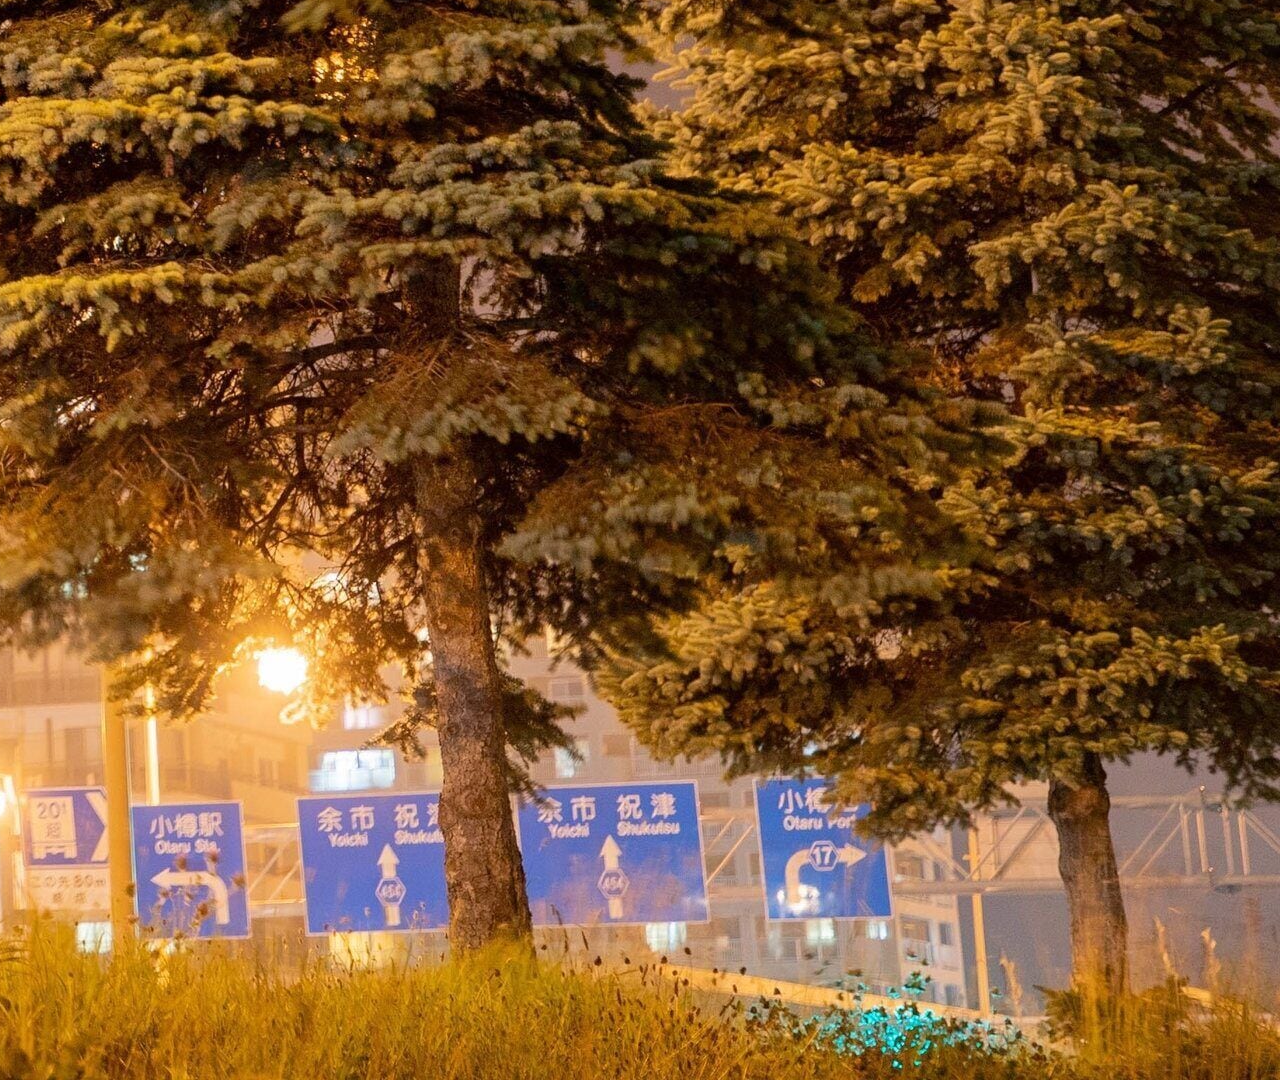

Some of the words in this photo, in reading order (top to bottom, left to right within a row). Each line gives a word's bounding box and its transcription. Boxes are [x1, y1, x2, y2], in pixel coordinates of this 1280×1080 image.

[537, 796, 596, 823] 余市
[616, 792, 677, 819] 祝津
[778, 787, 858, 814] 小樽
[149, 811, 224, 839] 小樽駅
[317, 805, 375, 832] 余市
[783, 815, 823, 832] Otaru
[548, 822, 590, 838] Yoichi
[617, 820, 680, 837] Shukutsu
[155, 840, 191, 855] Otaru
[328, 831, 369, 848] Yoichi
[813, 846, 834, 865] 17
